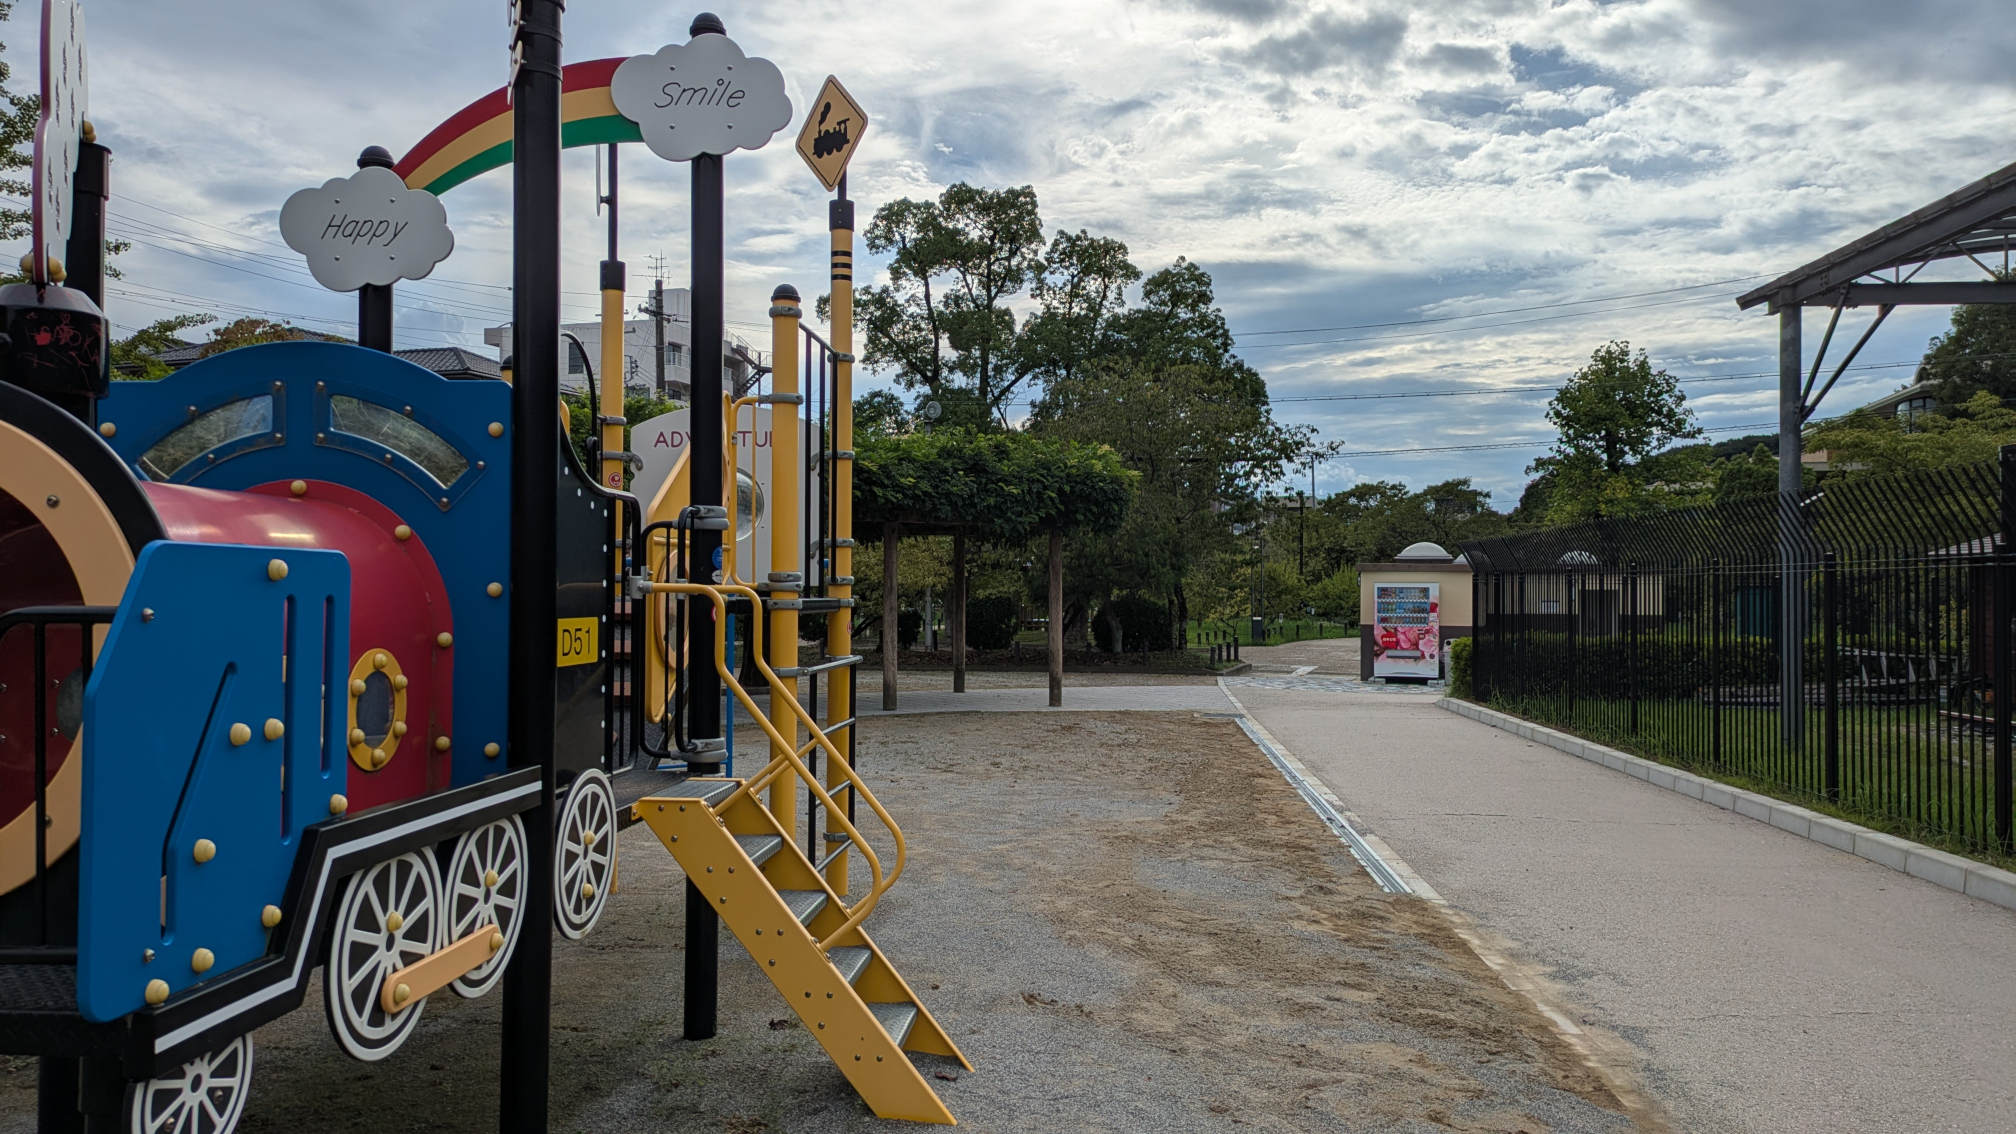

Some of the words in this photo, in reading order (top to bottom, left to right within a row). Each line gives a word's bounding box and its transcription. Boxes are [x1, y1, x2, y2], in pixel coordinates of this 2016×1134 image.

[653, 78, 746, 108] Smile
[321, 213, 409, 247] Happy
[562, 627, 591, 657] D51
